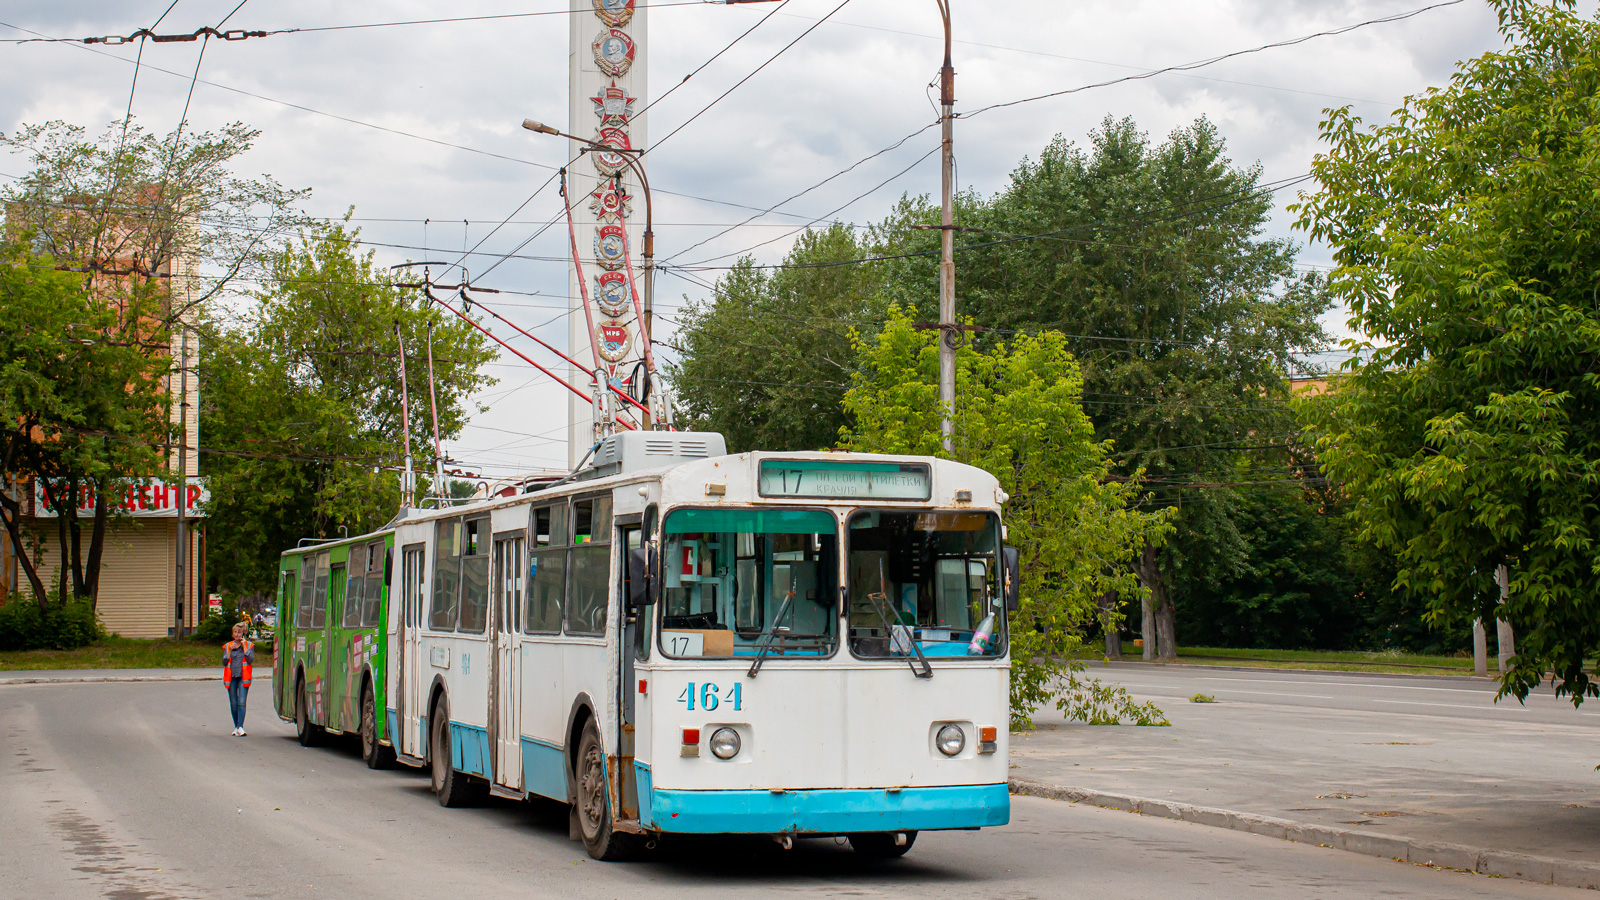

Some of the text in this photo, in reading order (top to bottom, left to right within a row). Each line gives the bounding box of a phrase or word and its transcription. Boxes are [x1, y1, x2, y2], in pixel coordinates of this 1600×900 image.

[779, 469, 803, 493] 17
[670, 637, 690, 656] 17
[677, 682, 743, 711] 464
